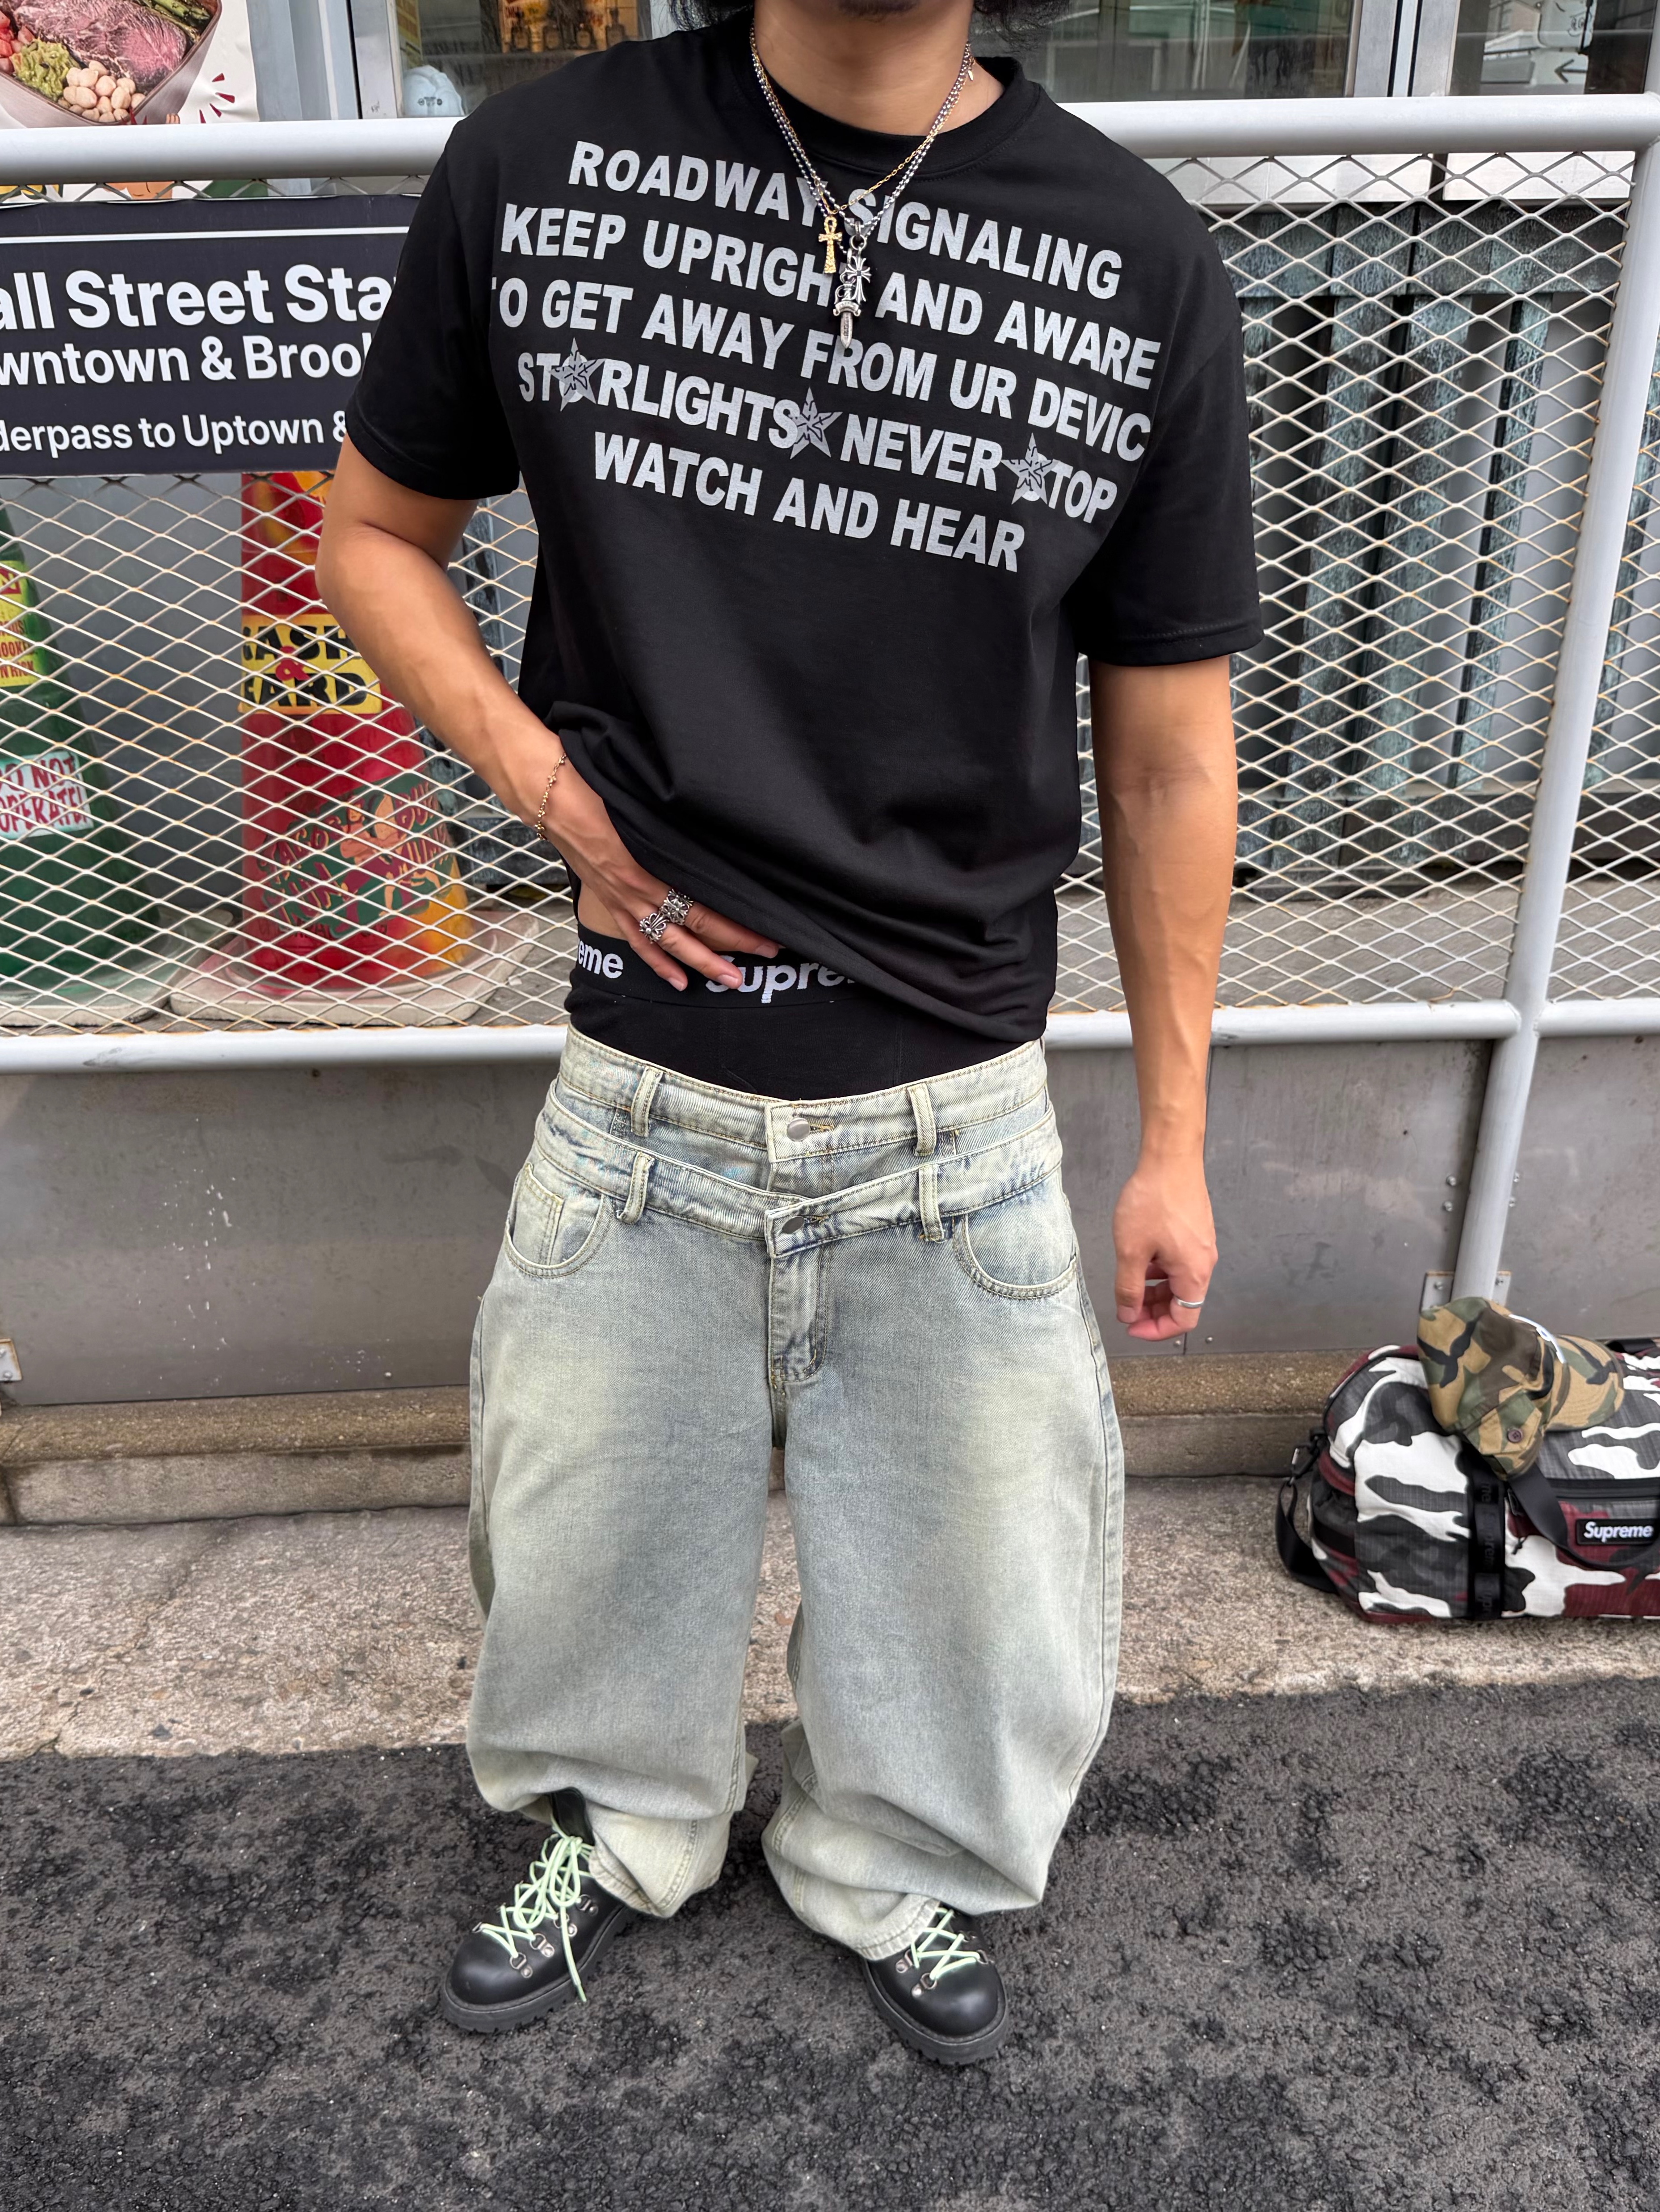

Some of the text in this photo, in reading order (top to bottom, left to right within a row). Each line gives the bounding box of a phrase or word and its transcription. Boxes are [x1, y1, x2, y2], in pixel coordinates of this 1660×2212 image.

[568, 141, 1122, 299] ROADWAY SIGNALING
[65, 270, 274, 328] Street
[285, 264, 396, 323] Sta
[500, 203, 1161, 390] KEEP UPRIGH AND AWARE
[0, 343, 190, 386] wntown
[201, 336, 236, 381] &
[542, 279, 634, 334] GET
[641, 293, 795, 370] AWAY
[800, 329, 937, 401] FROM
[950, 358, 1017, 419] UR
[1027, 378, 1151, 462] DEVIC
[138, 418, 176, 448] to
[182, 414, 324, 454] Uptown
[332, 410, 347, 443] &
[840, 413, 1003, 491] NEVER
[595, 431, 1025, 572] WATCH AND HEAR
[705, 955, 855, 1003] upre
[1583, 1521, 1654, 1543] Supreme
